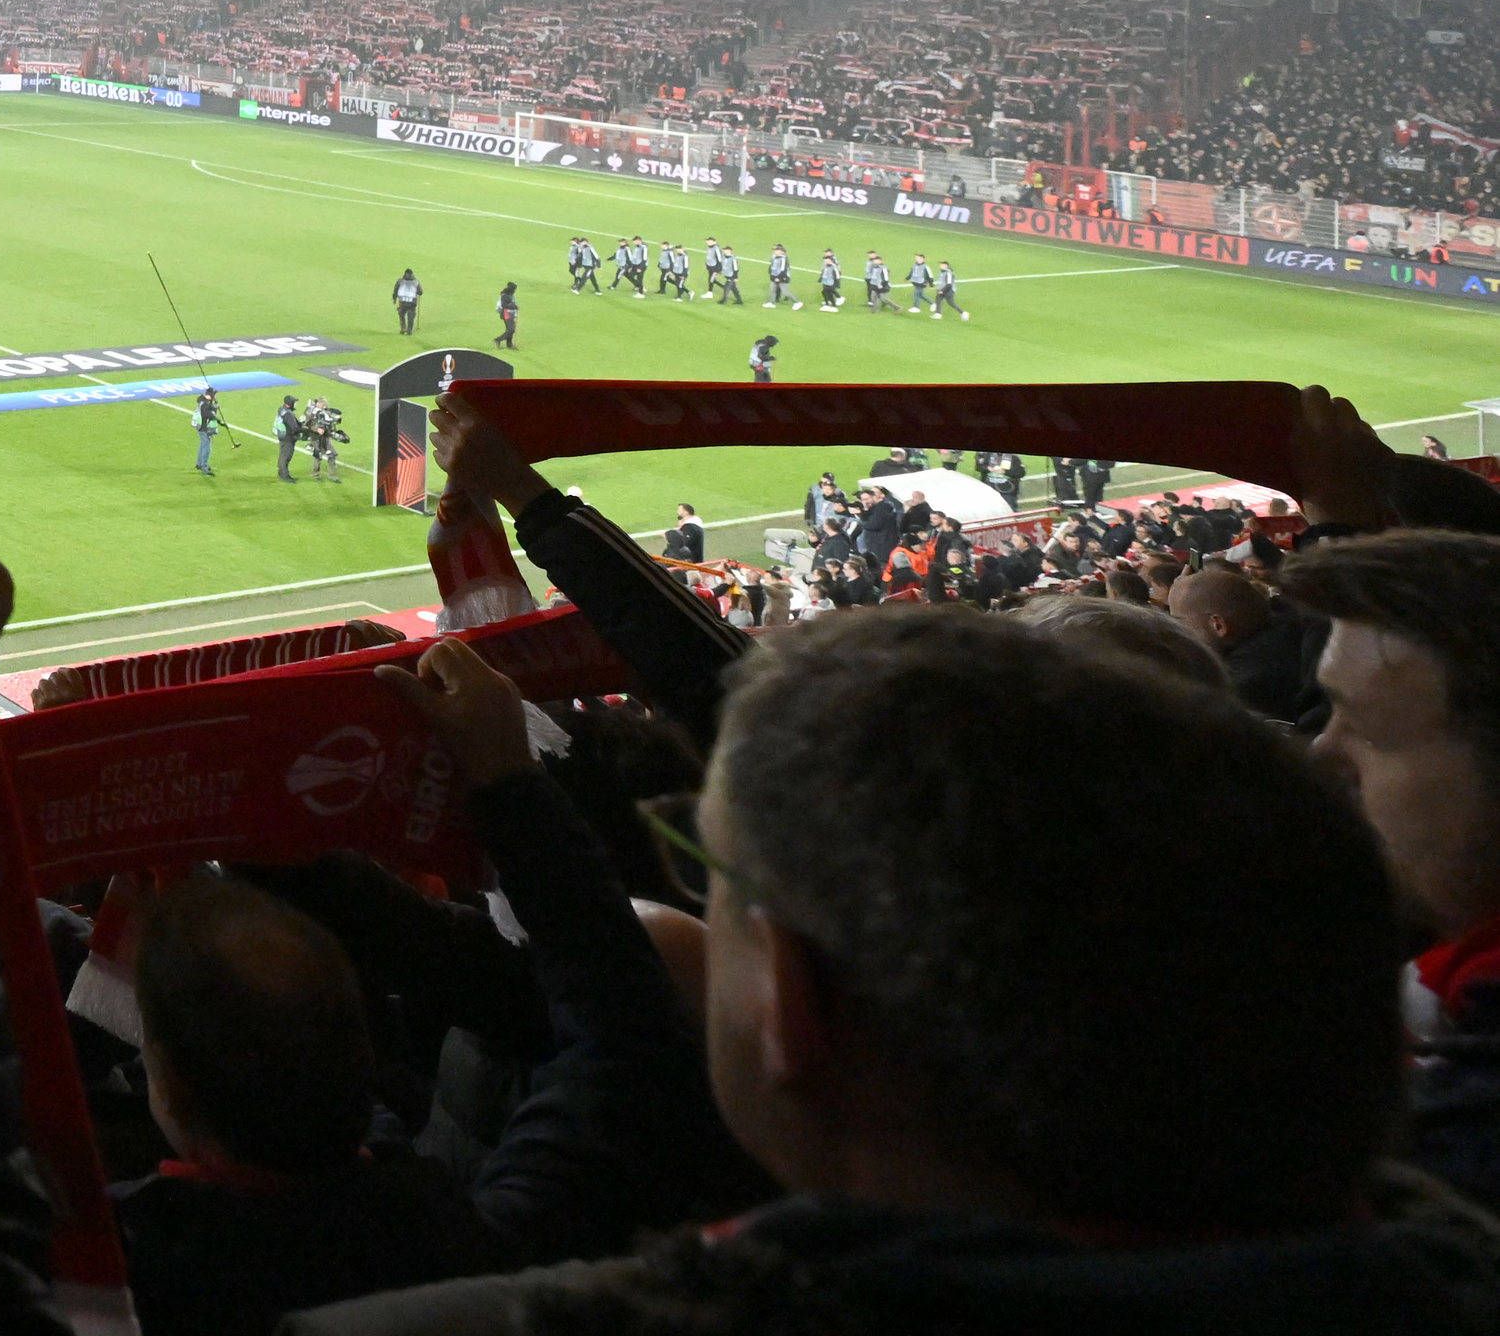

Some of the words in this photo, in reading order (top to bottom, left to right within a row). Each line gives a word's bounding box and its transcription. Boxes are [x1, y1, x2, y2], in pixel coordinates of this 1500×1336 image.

[60, 76, 140, 104] Heineken
[637, 157, 723, 186] STRAUSS
[772, 177, 869, 206] STRAUSS
[894, 192, 970, 224] bwin
[986, 203, 1242, 264] SPORTWETTEN
[1264, 247, 1336, 272] UEFA
